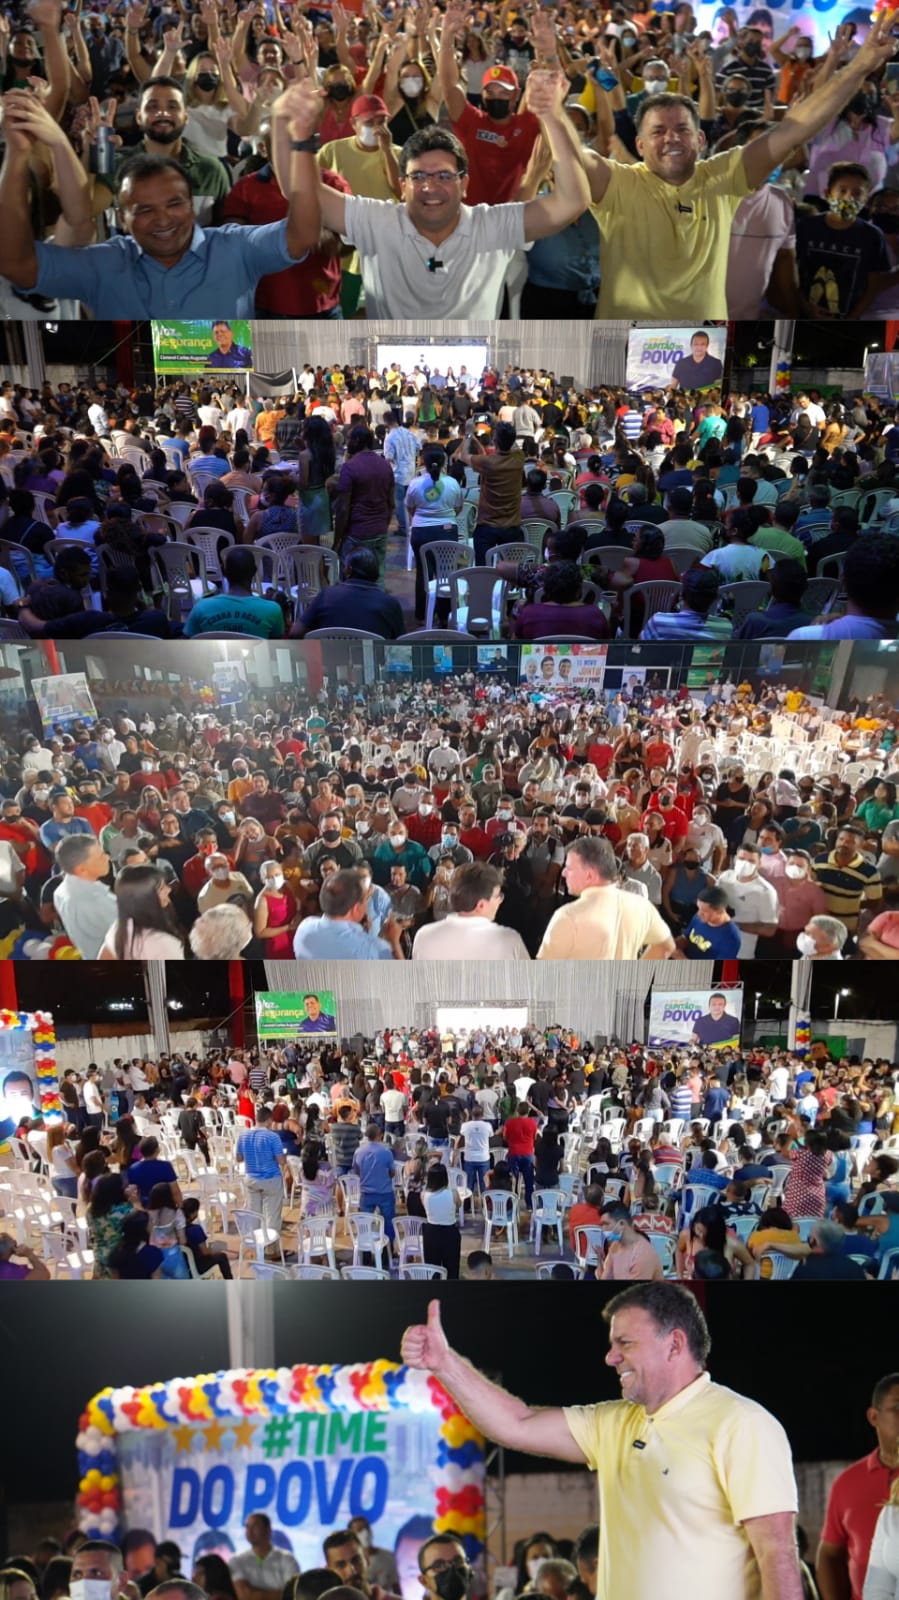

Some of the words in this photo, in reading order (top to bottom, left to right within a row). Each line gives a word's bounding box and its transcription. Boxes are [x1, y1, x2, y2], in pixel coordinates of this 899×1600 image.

[640, 350, 684, 365] POVO
[663, 1009, 703, 1022] POVO
[262, 1411, 389, 1458] #TIME
[169, 1464, 235, 1529] DO
[242, 1456, 389, 1529] POVO
